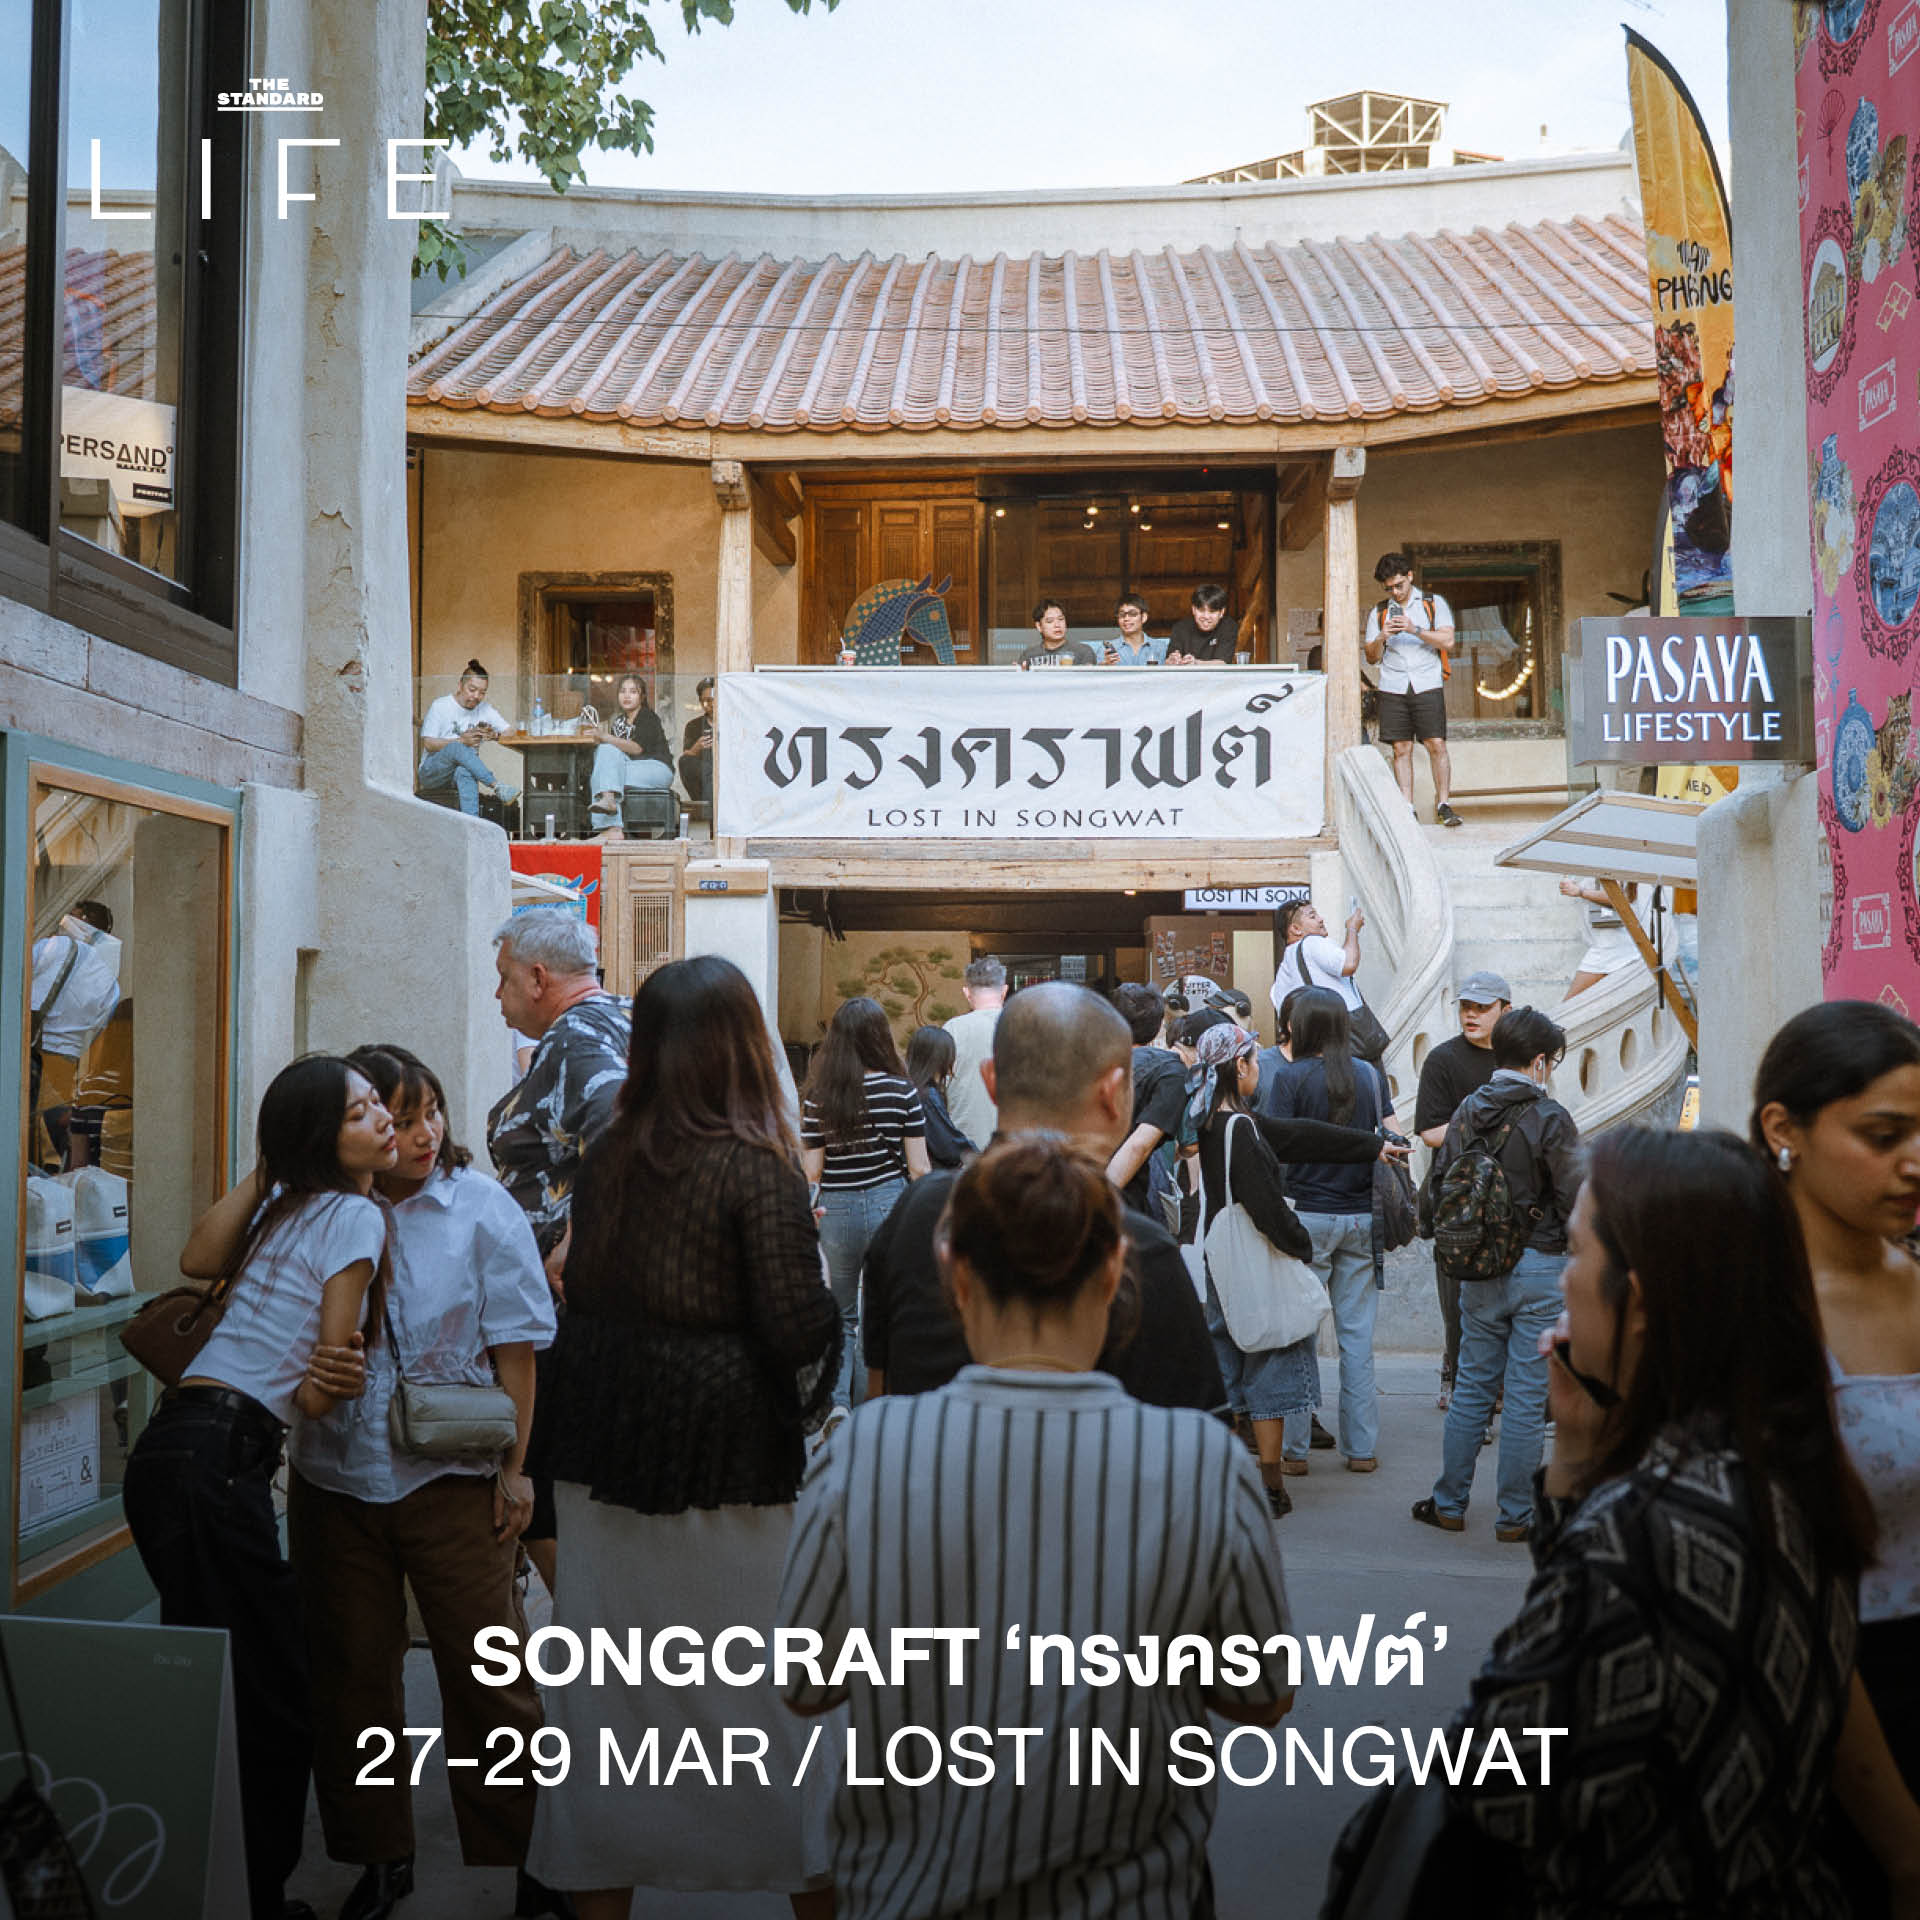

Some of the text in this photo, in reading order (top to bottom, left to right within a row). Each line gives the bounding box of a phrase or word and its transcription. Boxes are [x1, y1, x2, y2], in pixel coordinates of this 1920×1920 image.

[1605, 634, 1774, 704] PASAYA
[764, 682, 1294, 790] ทรงคราฟต์
[1602, 712, 1782, 742] LIFESTYLE
[868, 808, 1184, 828] LOST IN SONGWAT
[1195, 889, 1233, 903] LOST
[1240, 889, 1258, 903] IN
